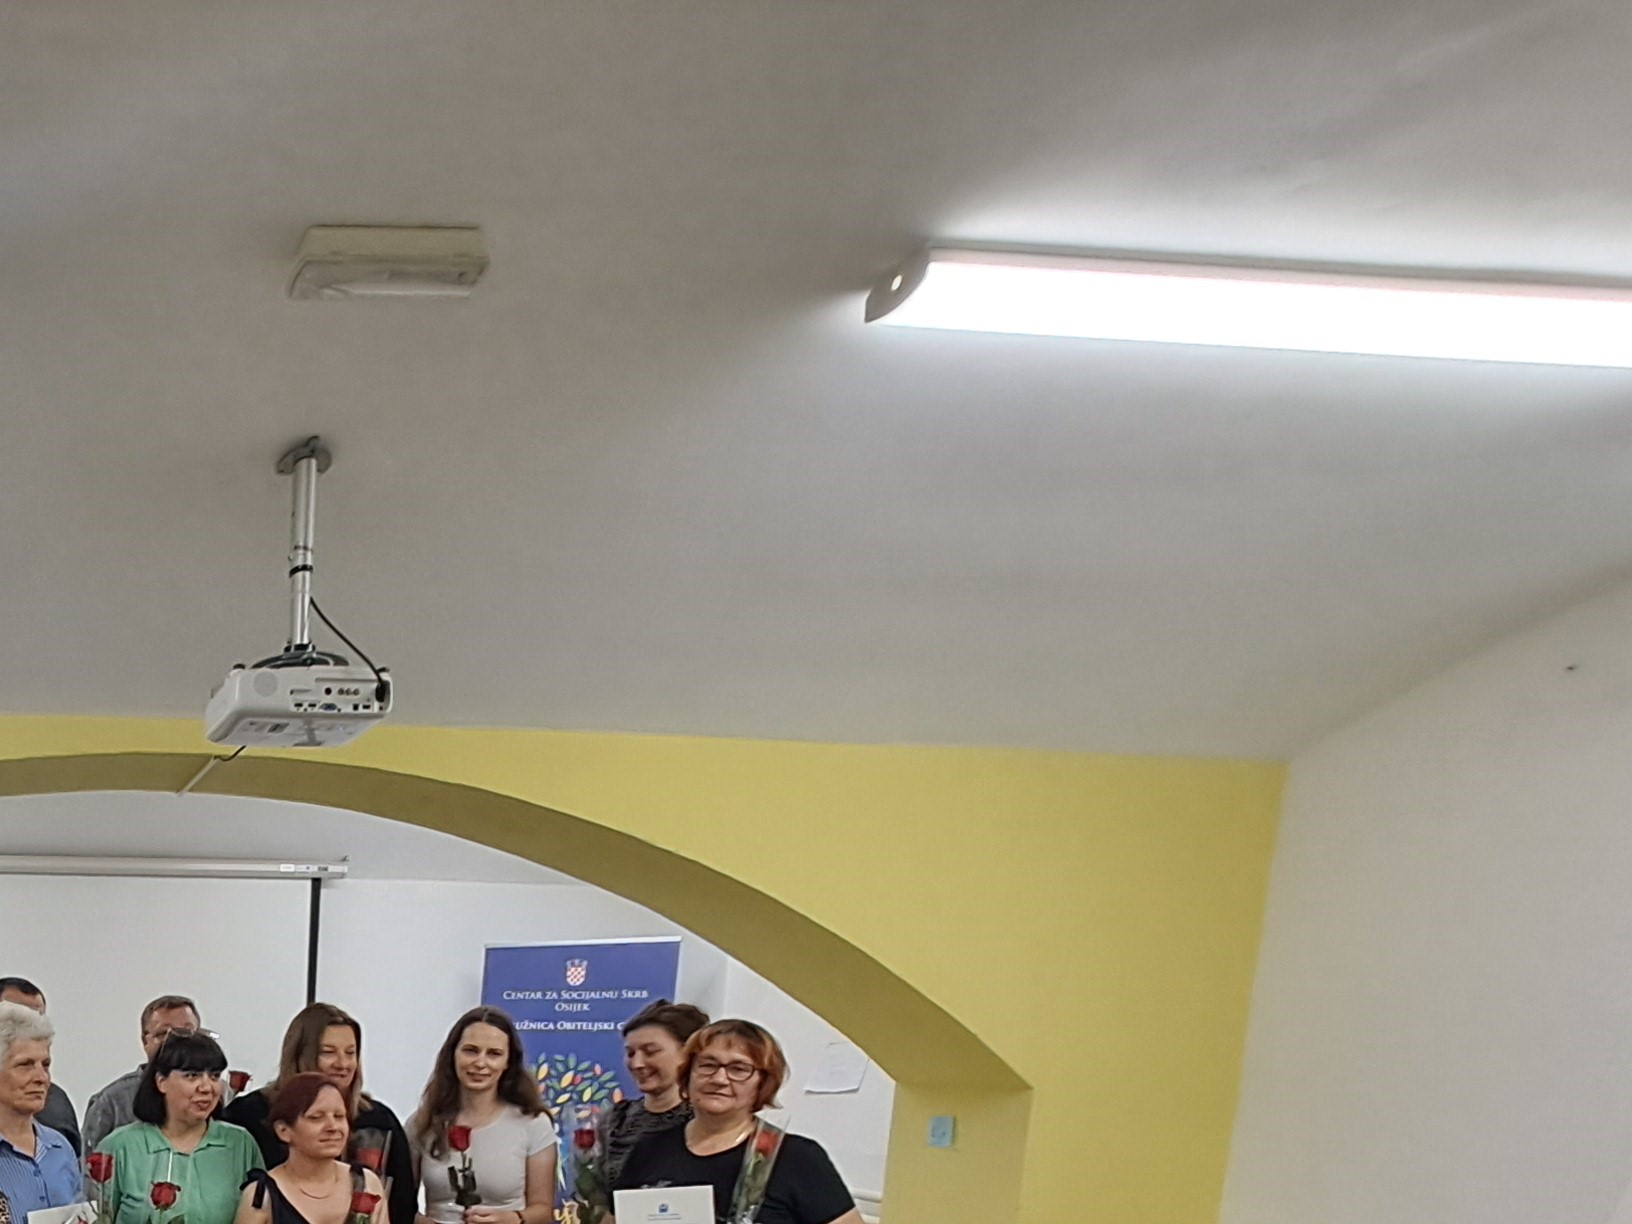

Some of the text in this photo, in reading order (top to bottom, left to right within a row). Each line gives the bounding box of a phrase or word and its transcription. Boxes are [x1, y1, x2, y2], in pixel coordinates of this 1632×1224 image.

[503, 990, 542, 1000] CENTAR
[560, 989, 618, 1000] SOCIJALNU
[621, 989, 649, 999] SKRB
[554, 1002, 590, 1013] OSIJEK
[557, 1021, 615, 1032] OBITELJSKI
